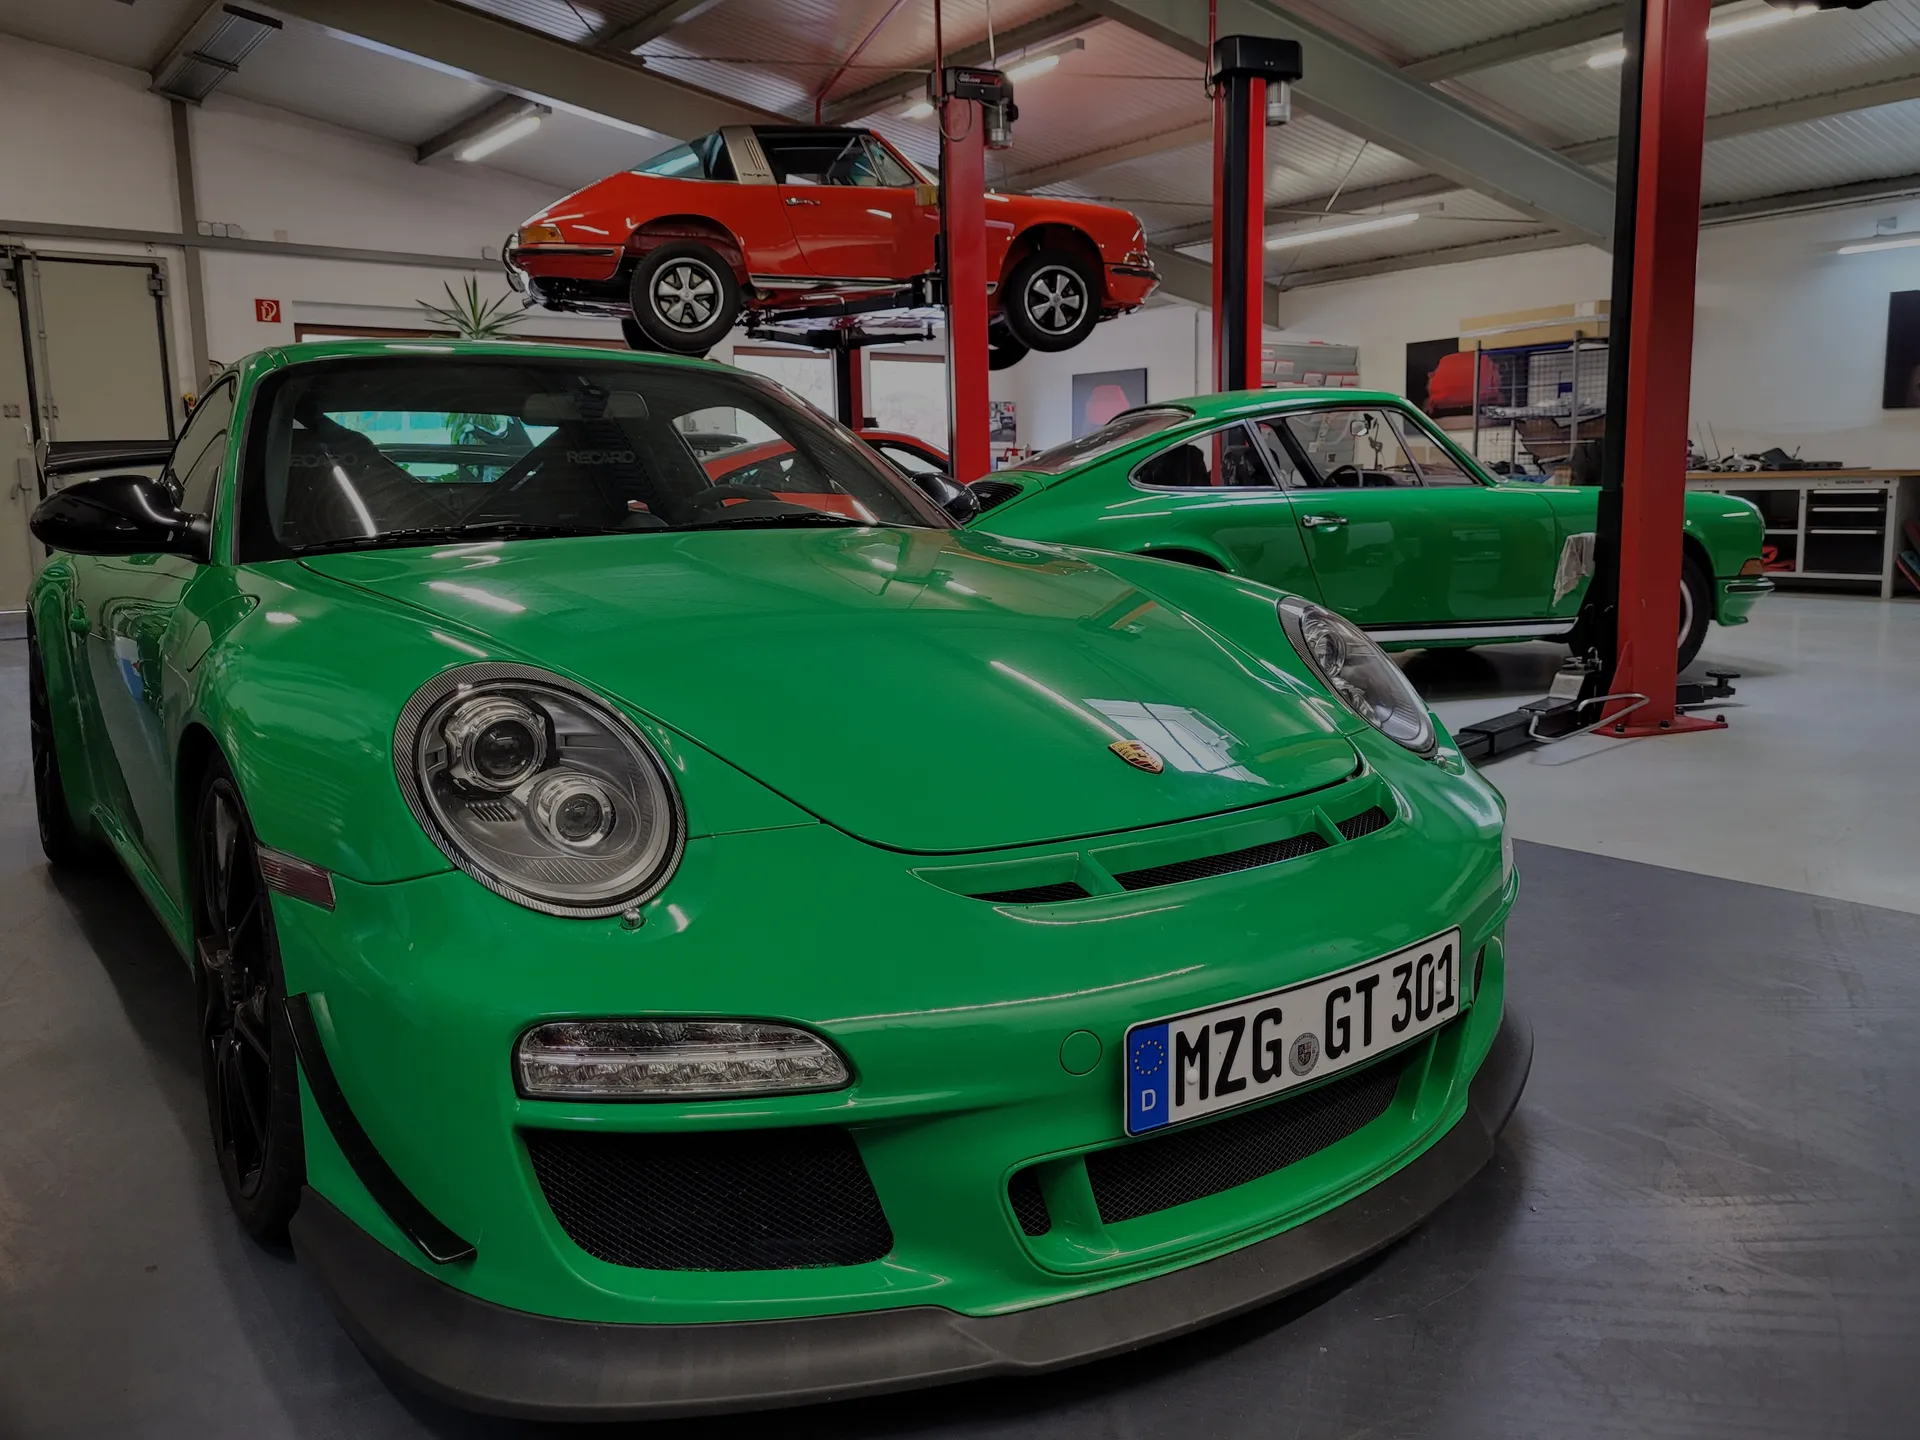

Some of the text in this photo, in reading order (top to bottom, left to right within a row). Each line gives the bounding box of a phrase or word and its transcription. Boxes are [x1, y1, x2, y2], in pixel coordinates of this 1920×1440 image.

[566, 449, 636, 465] RECARO
[1175, 1007, 1283, 1107] MZG
[1325, 973, 1379, 1060] GT
[1391, 943, 1455, 1033] 301
[1141, 1088, 1157, 1112] D
